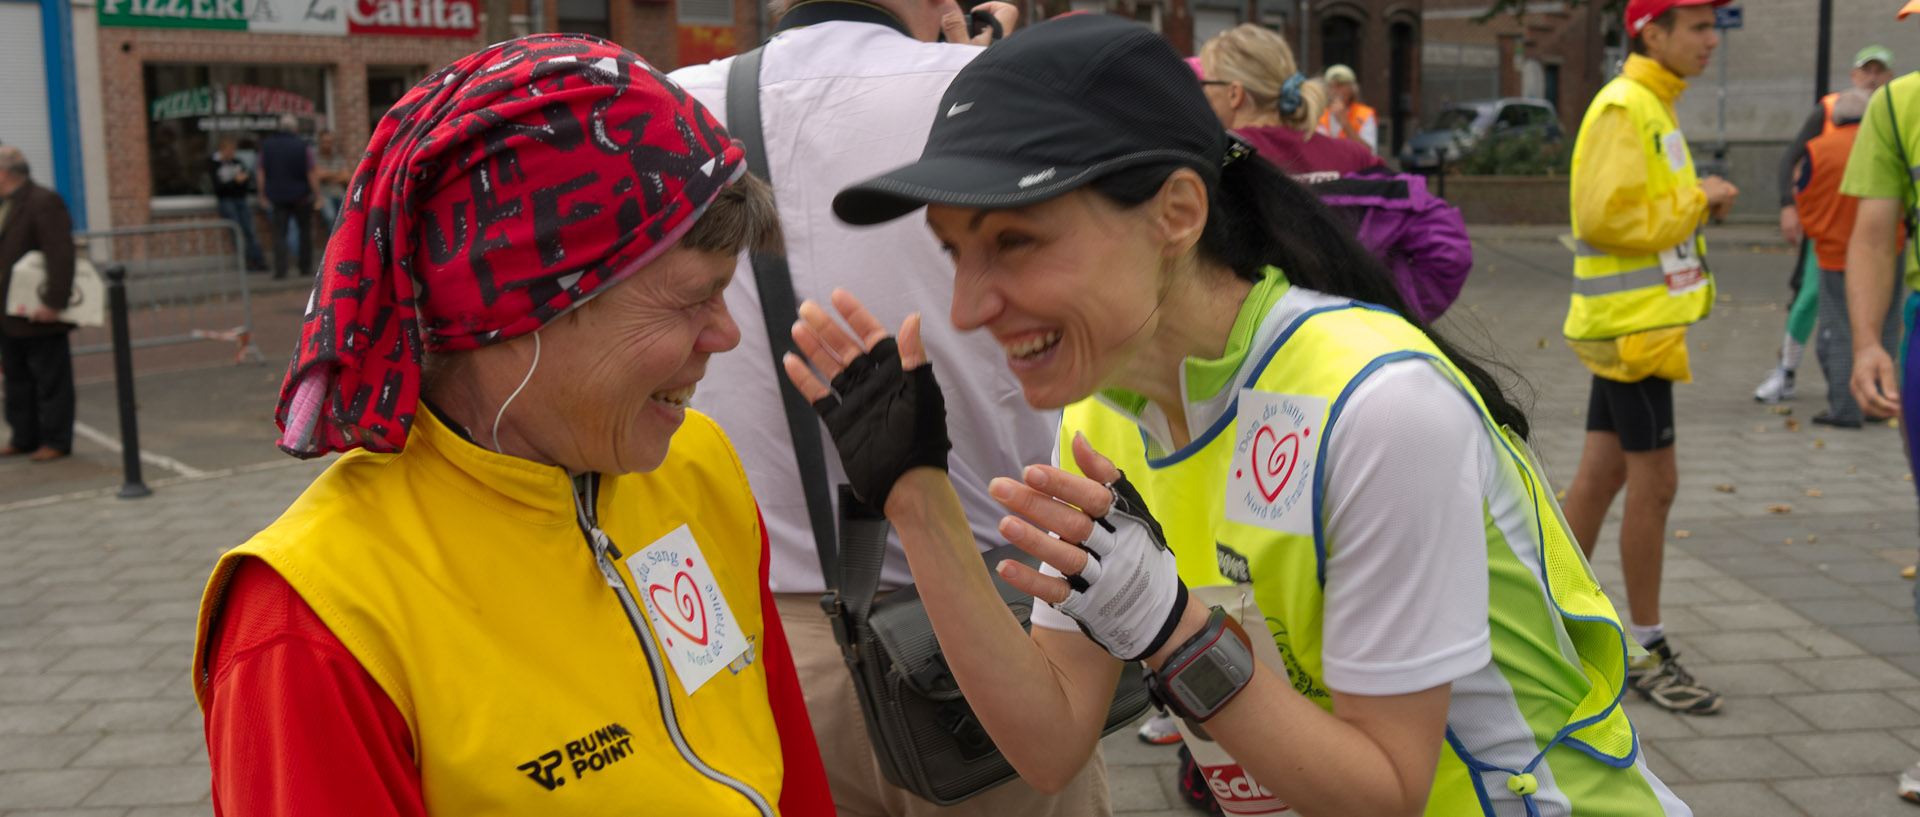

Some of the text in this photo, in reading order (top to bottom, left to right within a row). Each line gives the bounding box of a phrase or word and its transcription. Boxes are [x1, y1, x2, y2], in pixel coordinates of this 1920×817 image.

[349, 0, 476, 30] Catita
[1239, 399, 1305, 454] Don du Sang
[1244, 459, 1311, 520] Nord de France
[636, 562, 651, 584] du
[646, 549, 680, 568] Sang
[687, 583, 726, 667] Nord de France
[571, 737, 635, 780] POINT
